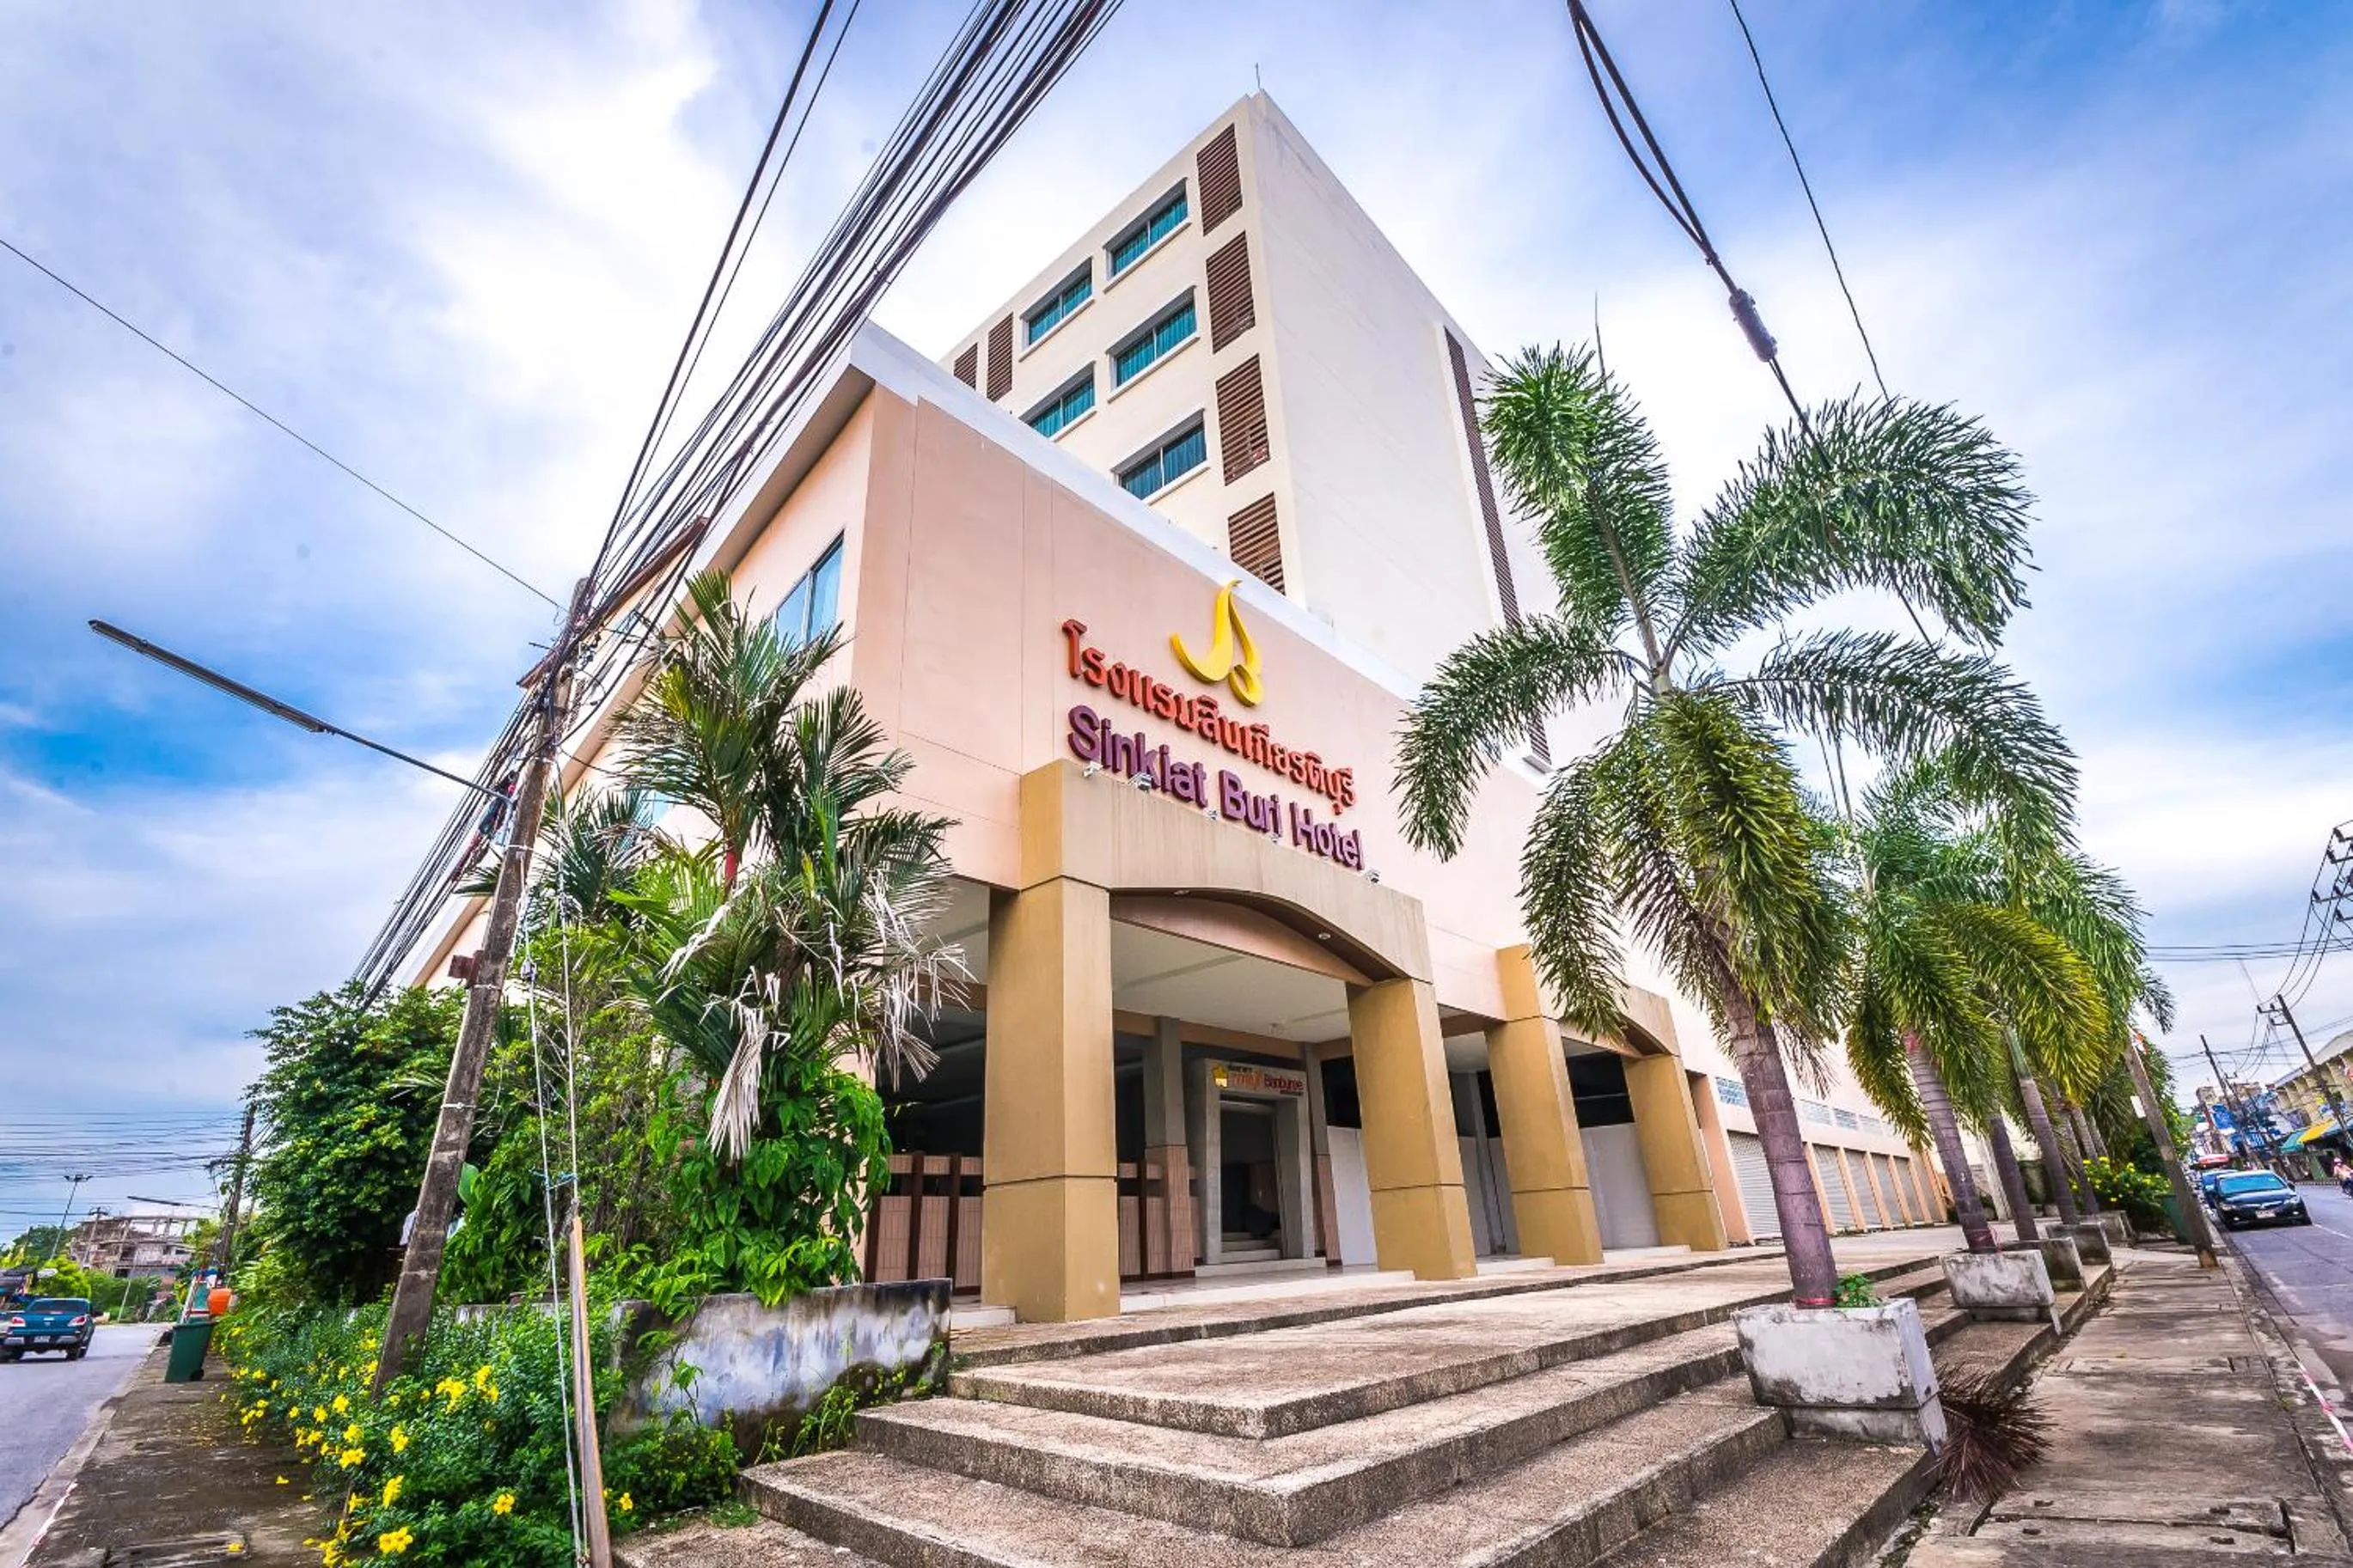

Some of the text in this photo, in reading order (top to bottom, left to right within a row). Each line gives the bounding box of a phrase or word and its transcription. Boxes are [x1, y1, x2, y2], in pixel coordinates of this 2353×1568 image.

[1067, 705, 1365, 871] Sinkiat Buri Hotel
